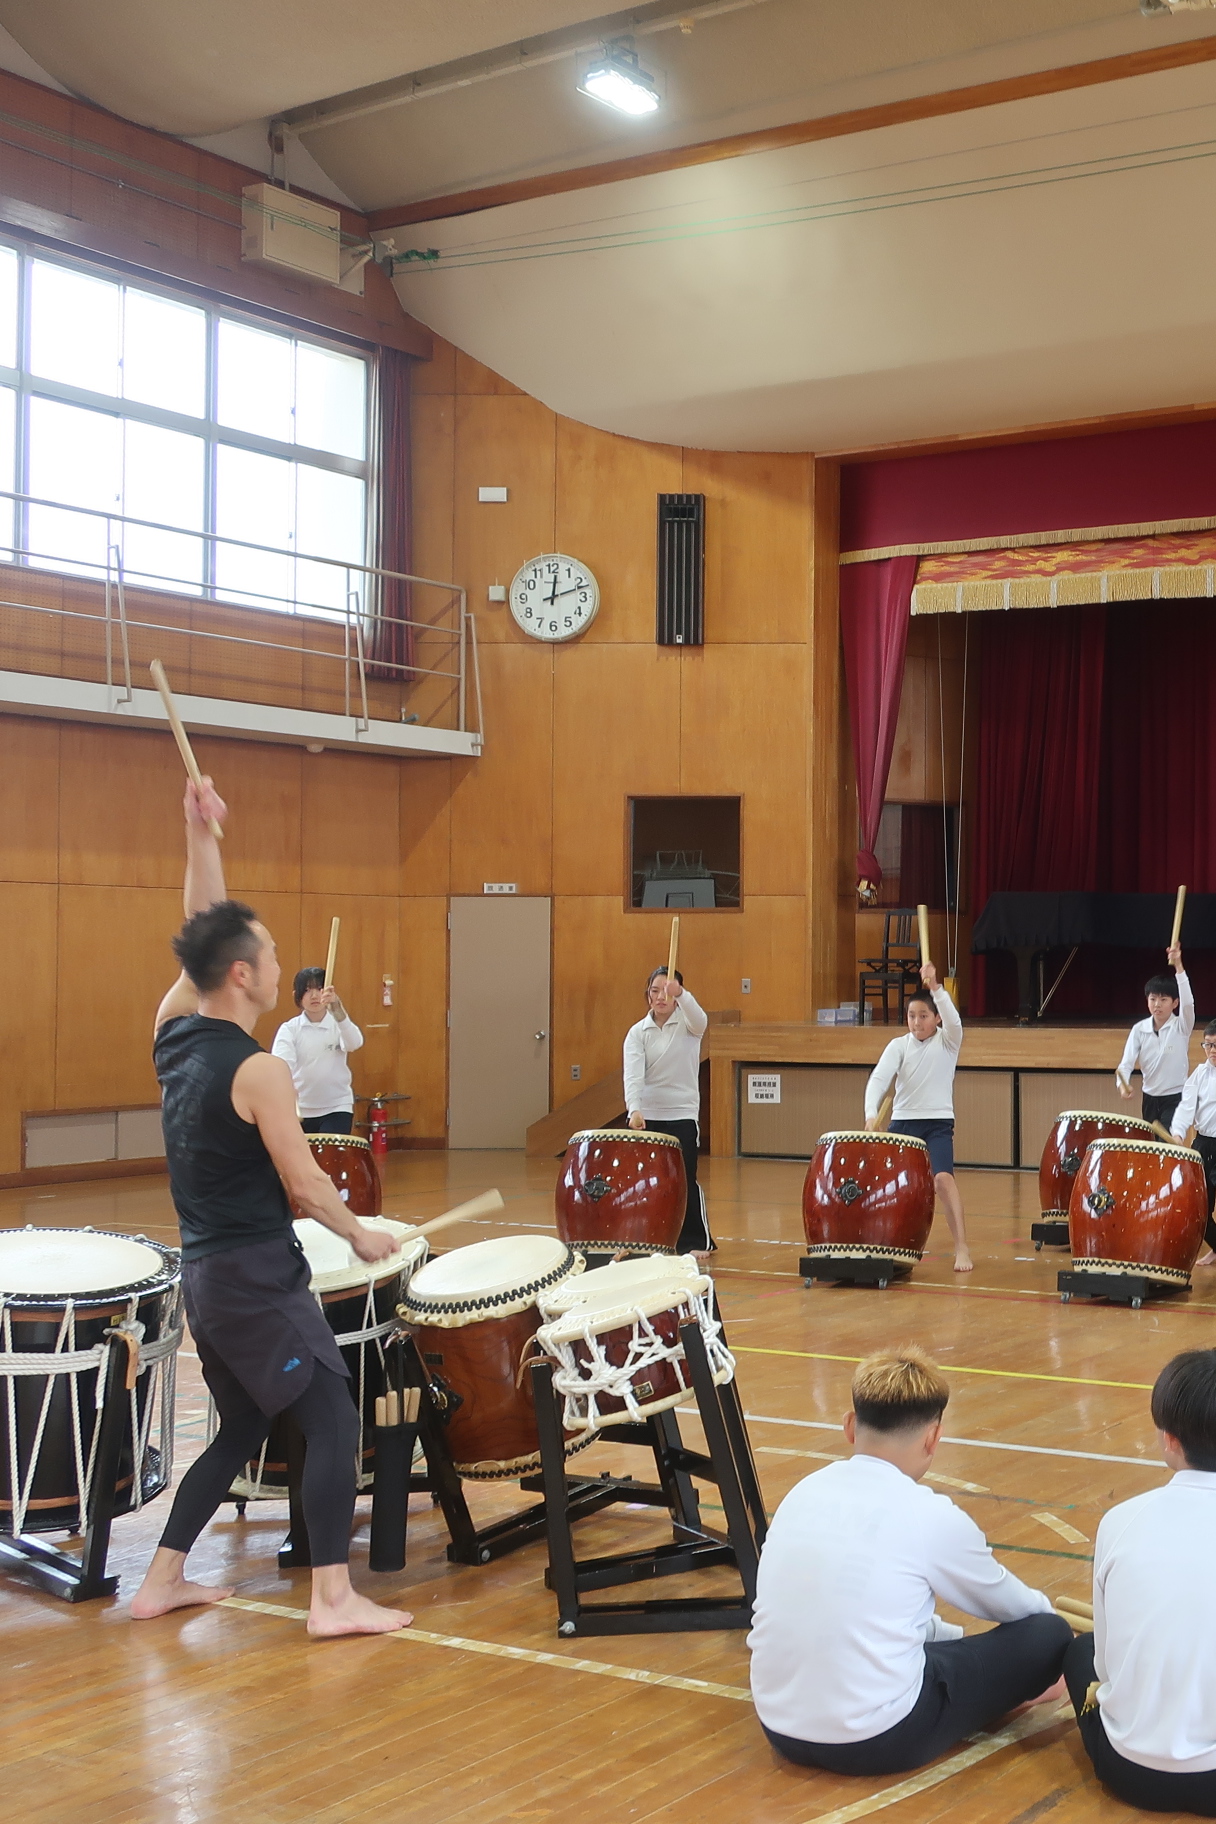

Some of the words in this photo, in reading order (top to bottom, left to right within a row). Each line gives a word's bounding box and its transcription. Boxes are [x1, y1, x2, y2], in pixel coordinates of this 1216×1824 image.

[532, 568, 543, 578] 11
[545, 563, 559, 574] 12
[565, 567, 571, 578] 1
[522, 579, 536, 590] 10
[574, 576, 583, 588] 2
[519, 593, 528, 604] 9
[579, 591, 587, 603] 3
[524, 607, 533, 618] 8
[574, 606, 582, 617] 4
[536, 617, 544, 628] 7
[549, 621, 558, 632] 6
[564, 616, 573, 627] 5
